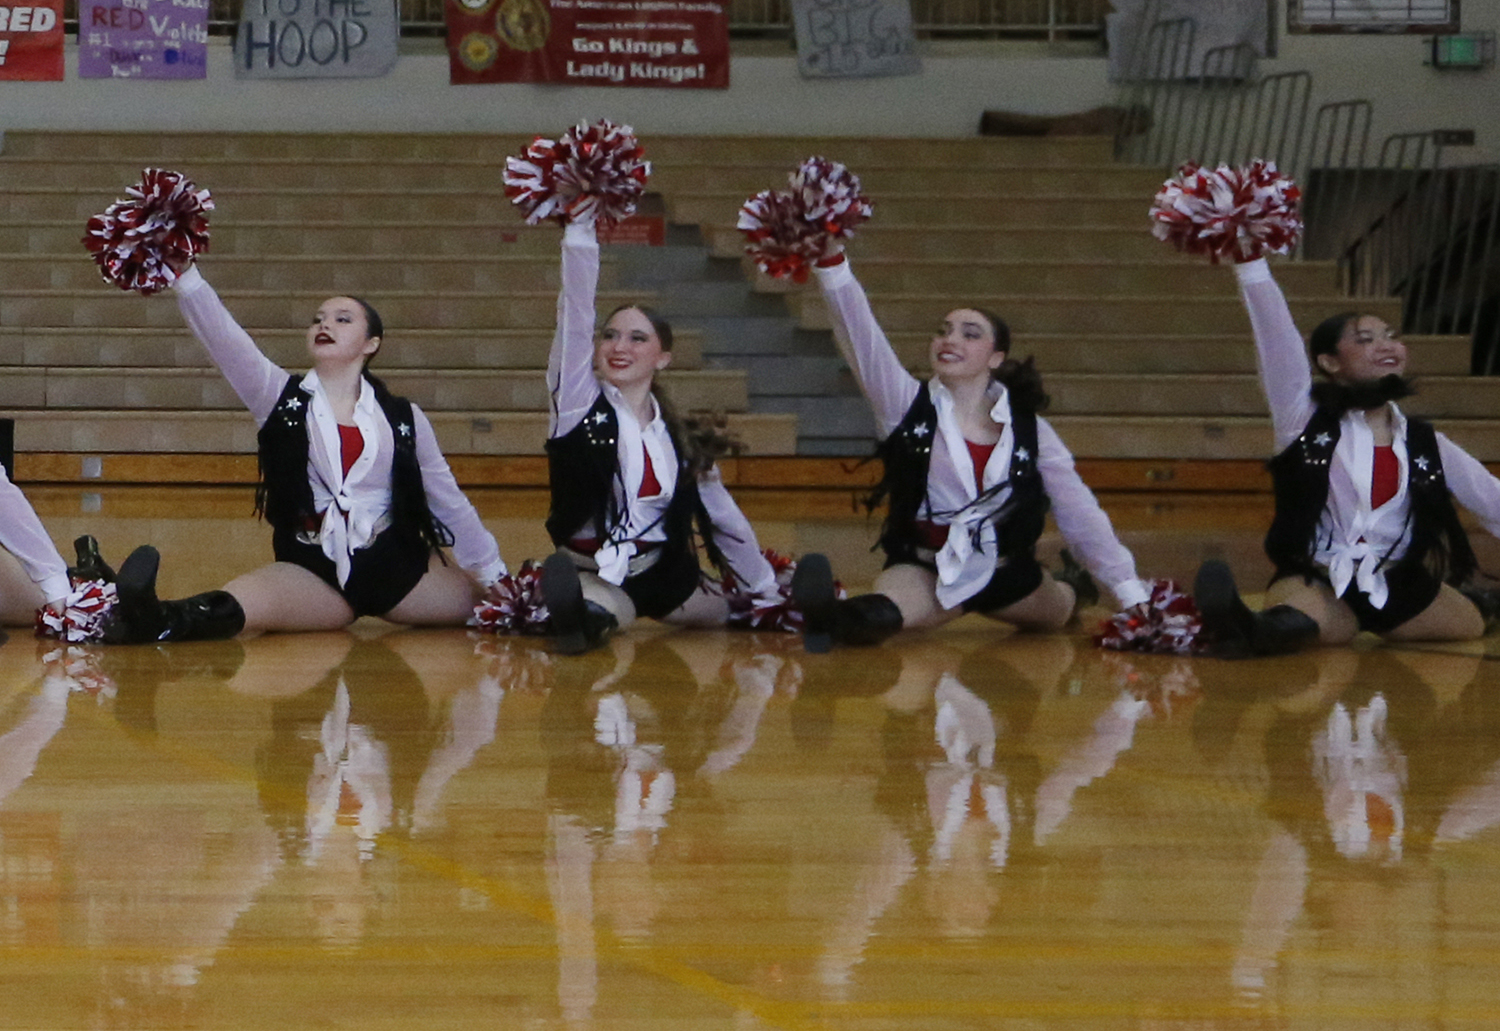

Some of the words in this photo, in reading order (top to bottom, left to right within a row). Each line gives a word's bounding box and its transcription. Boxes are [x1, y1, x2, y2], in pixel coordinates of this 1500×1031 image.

[91, 5, 145, 31] RED
[244, 20, 368, 69] HOOP
[572, 37, 604, 53] Go
[609, 37, 677, 58] Kings
[681, 38, 699, 55] &
[566, 60, 625, 82] Lady
[630, 61, 706, 82] Kings!
